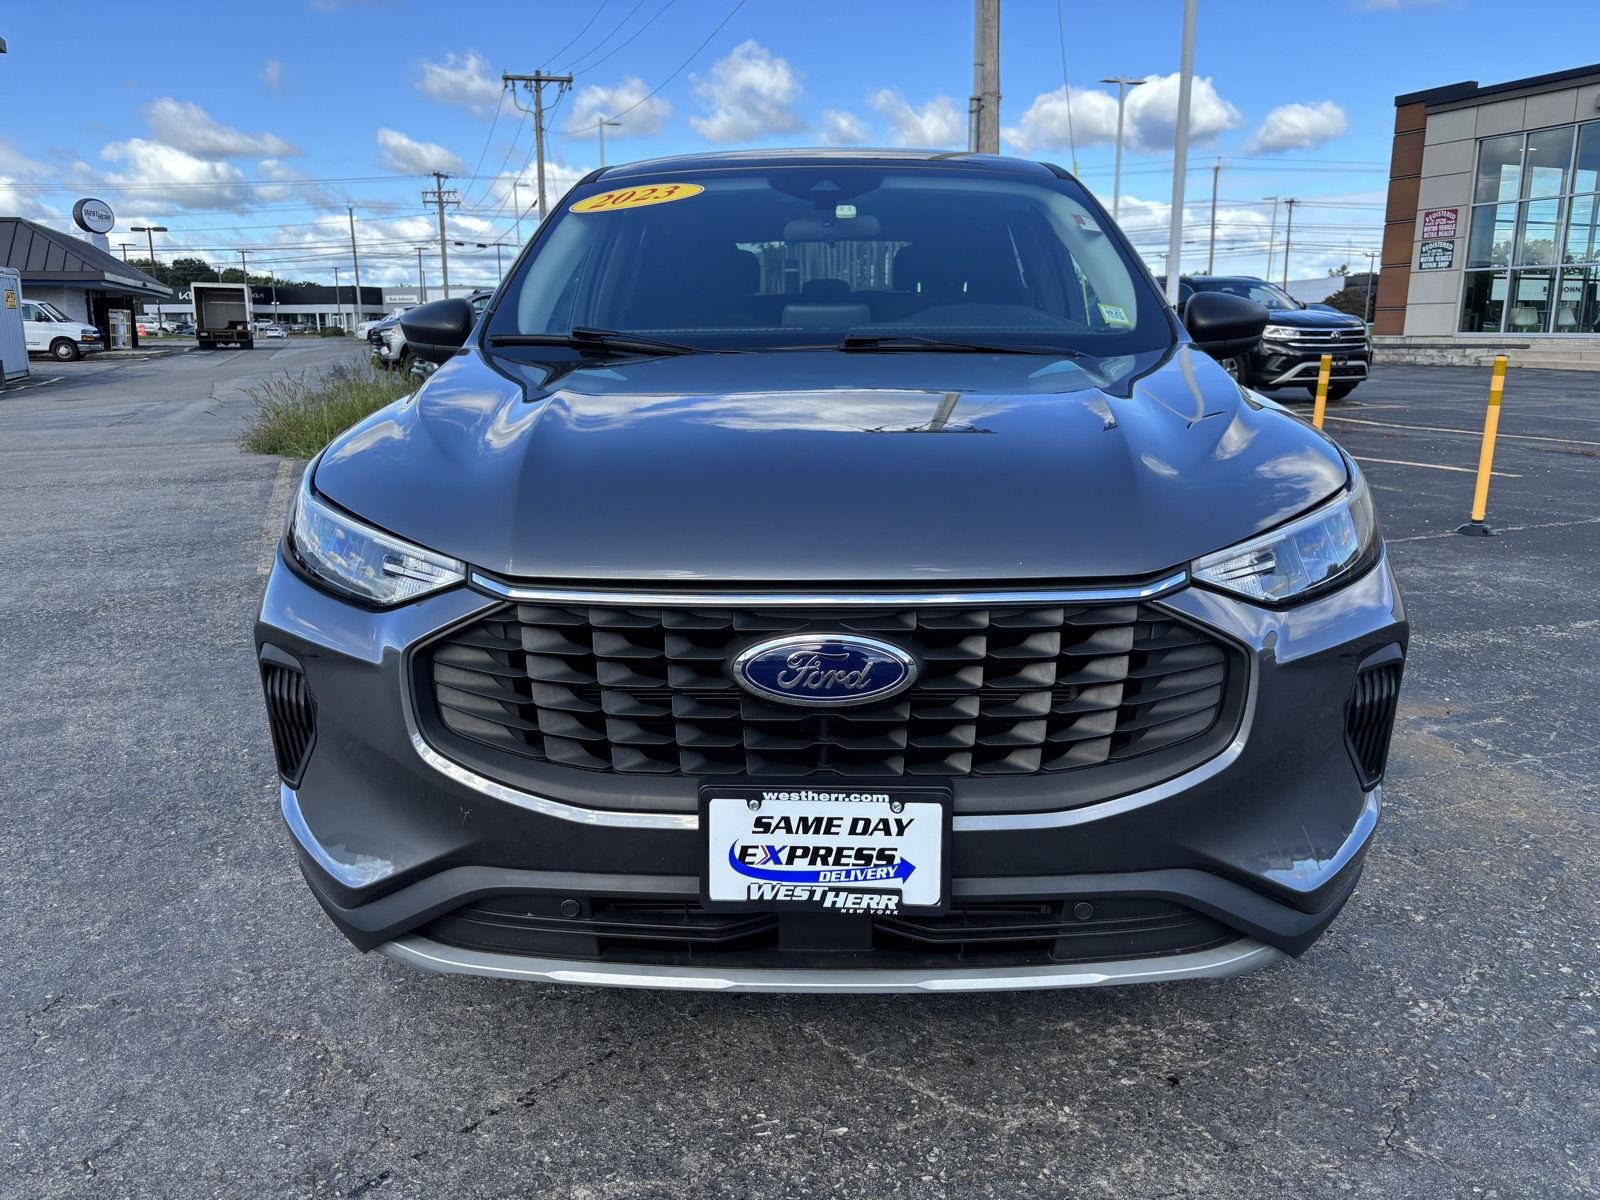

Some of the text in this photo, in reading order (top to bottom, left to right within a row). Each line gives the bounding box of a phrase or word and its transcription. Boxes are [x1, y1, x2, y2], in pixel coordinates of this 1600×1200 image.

[588, 186, 680, 209] 2023
[1425, 210, 1456, 222] REGISTERED
[1422, 241, 1453, 252] REGISTERED
[777, 650, 875, 690] Ford
[762, 791, 890, 803] westherr.com
[751, 815, 915, 837] SAME DAY
[737, 844, 898, 867] EXPRESS
[818, 866, 898, 883] DELIVERY
